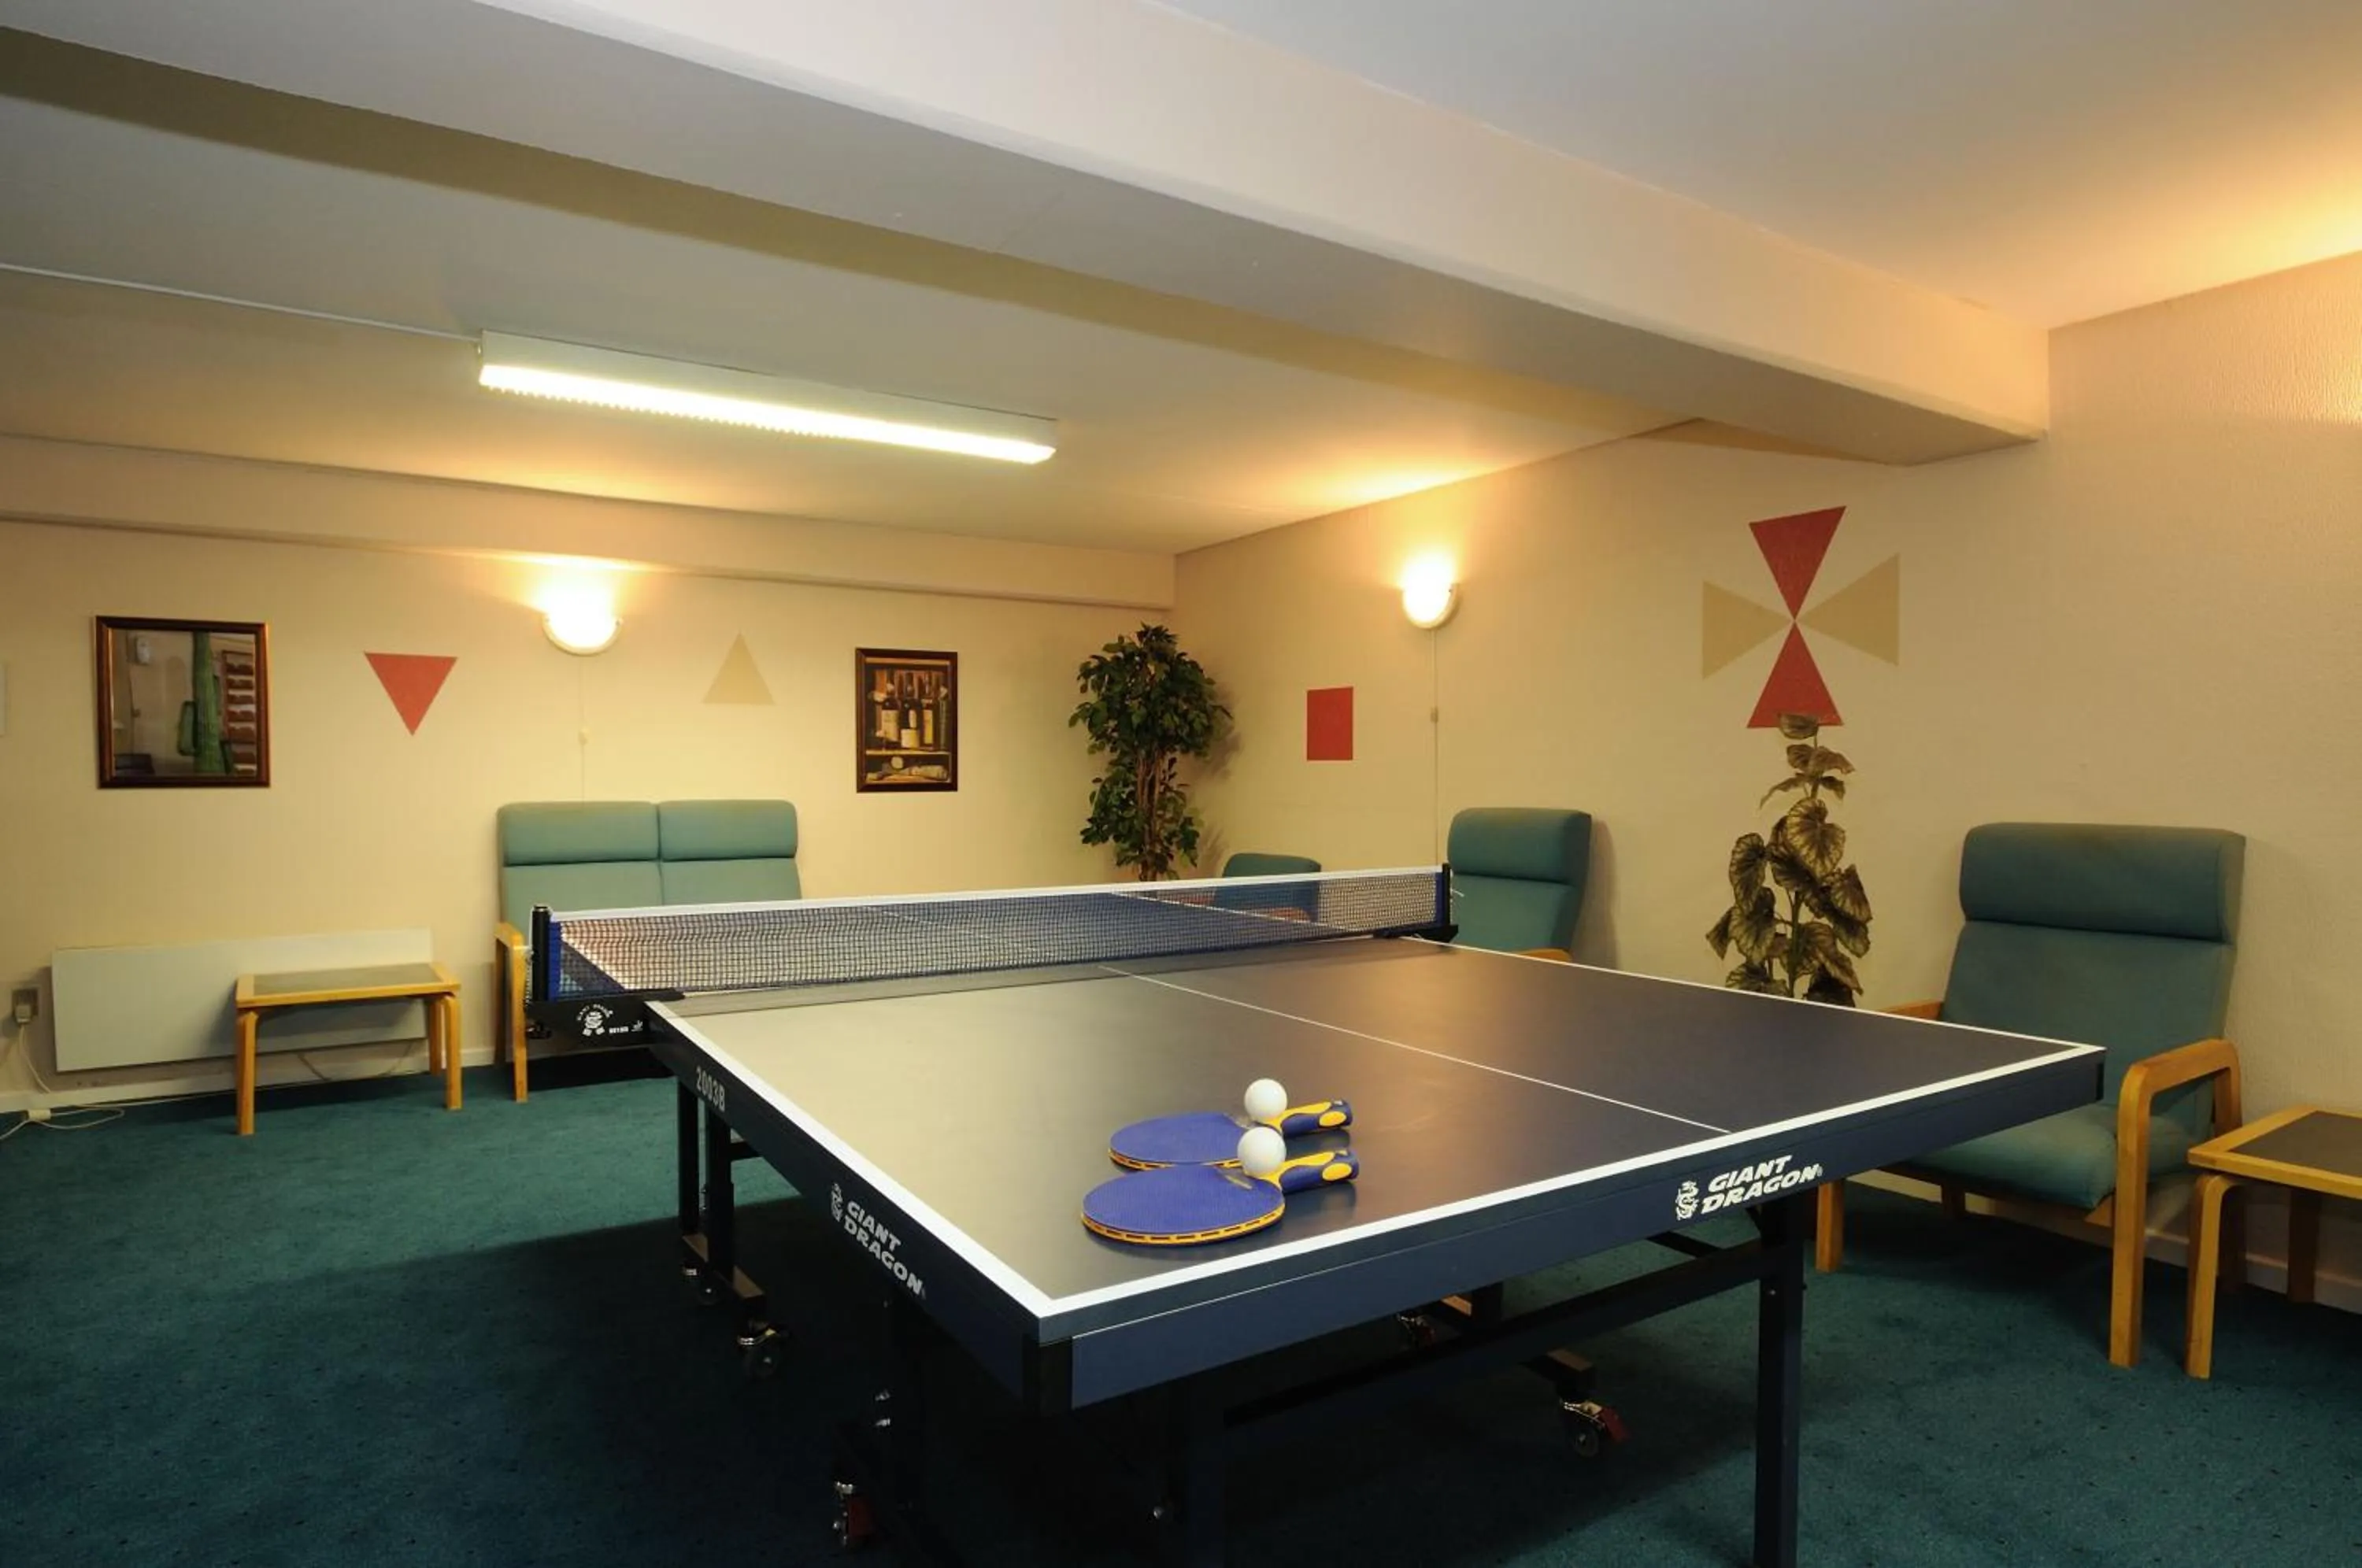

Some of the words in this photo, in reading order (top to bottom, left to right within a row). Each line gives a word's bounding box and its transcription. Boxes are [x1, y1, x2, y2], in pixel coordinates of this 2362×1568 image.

[1701, 1163, 1820, 1215] DRAGON
[1708, 1156, 1792, 1193] GIANT
[847, 1201, 901, 1252] GIANT
[844, 1215, 923, 1295] DRAGON
